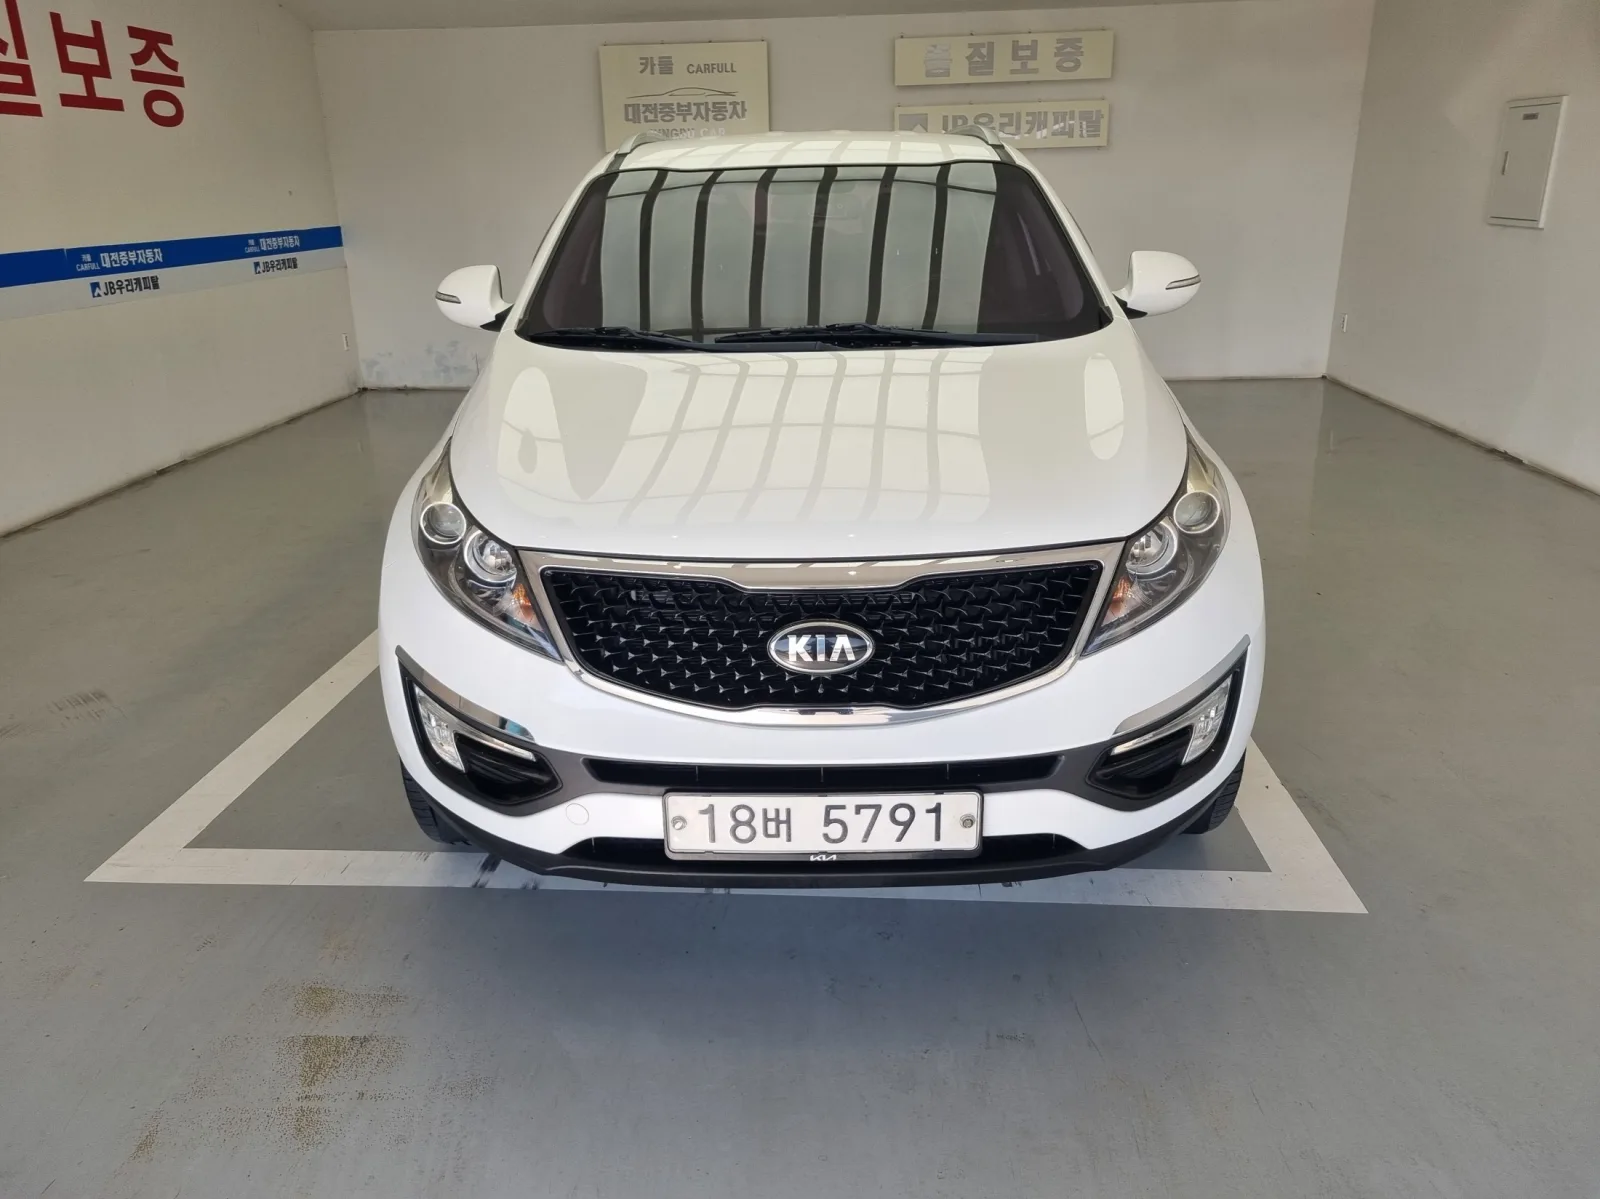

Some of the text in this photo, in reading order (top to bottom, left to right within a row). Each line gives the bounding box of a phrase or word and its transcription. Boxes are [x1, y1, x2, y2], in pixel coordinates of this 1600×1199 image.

[686, 62, 737, 74] CARFULL
[624, 101, 747, 124] 대전중부자동차
[76, 262, 100, 271] CARFULL
[100, 248, 163, 268] 대전중부자동차
[103, 275, 160, 296] JB우리캐피탈
[786, 634, 856, 662] KIA
[698, 802, 942, 844] 18버 5791
